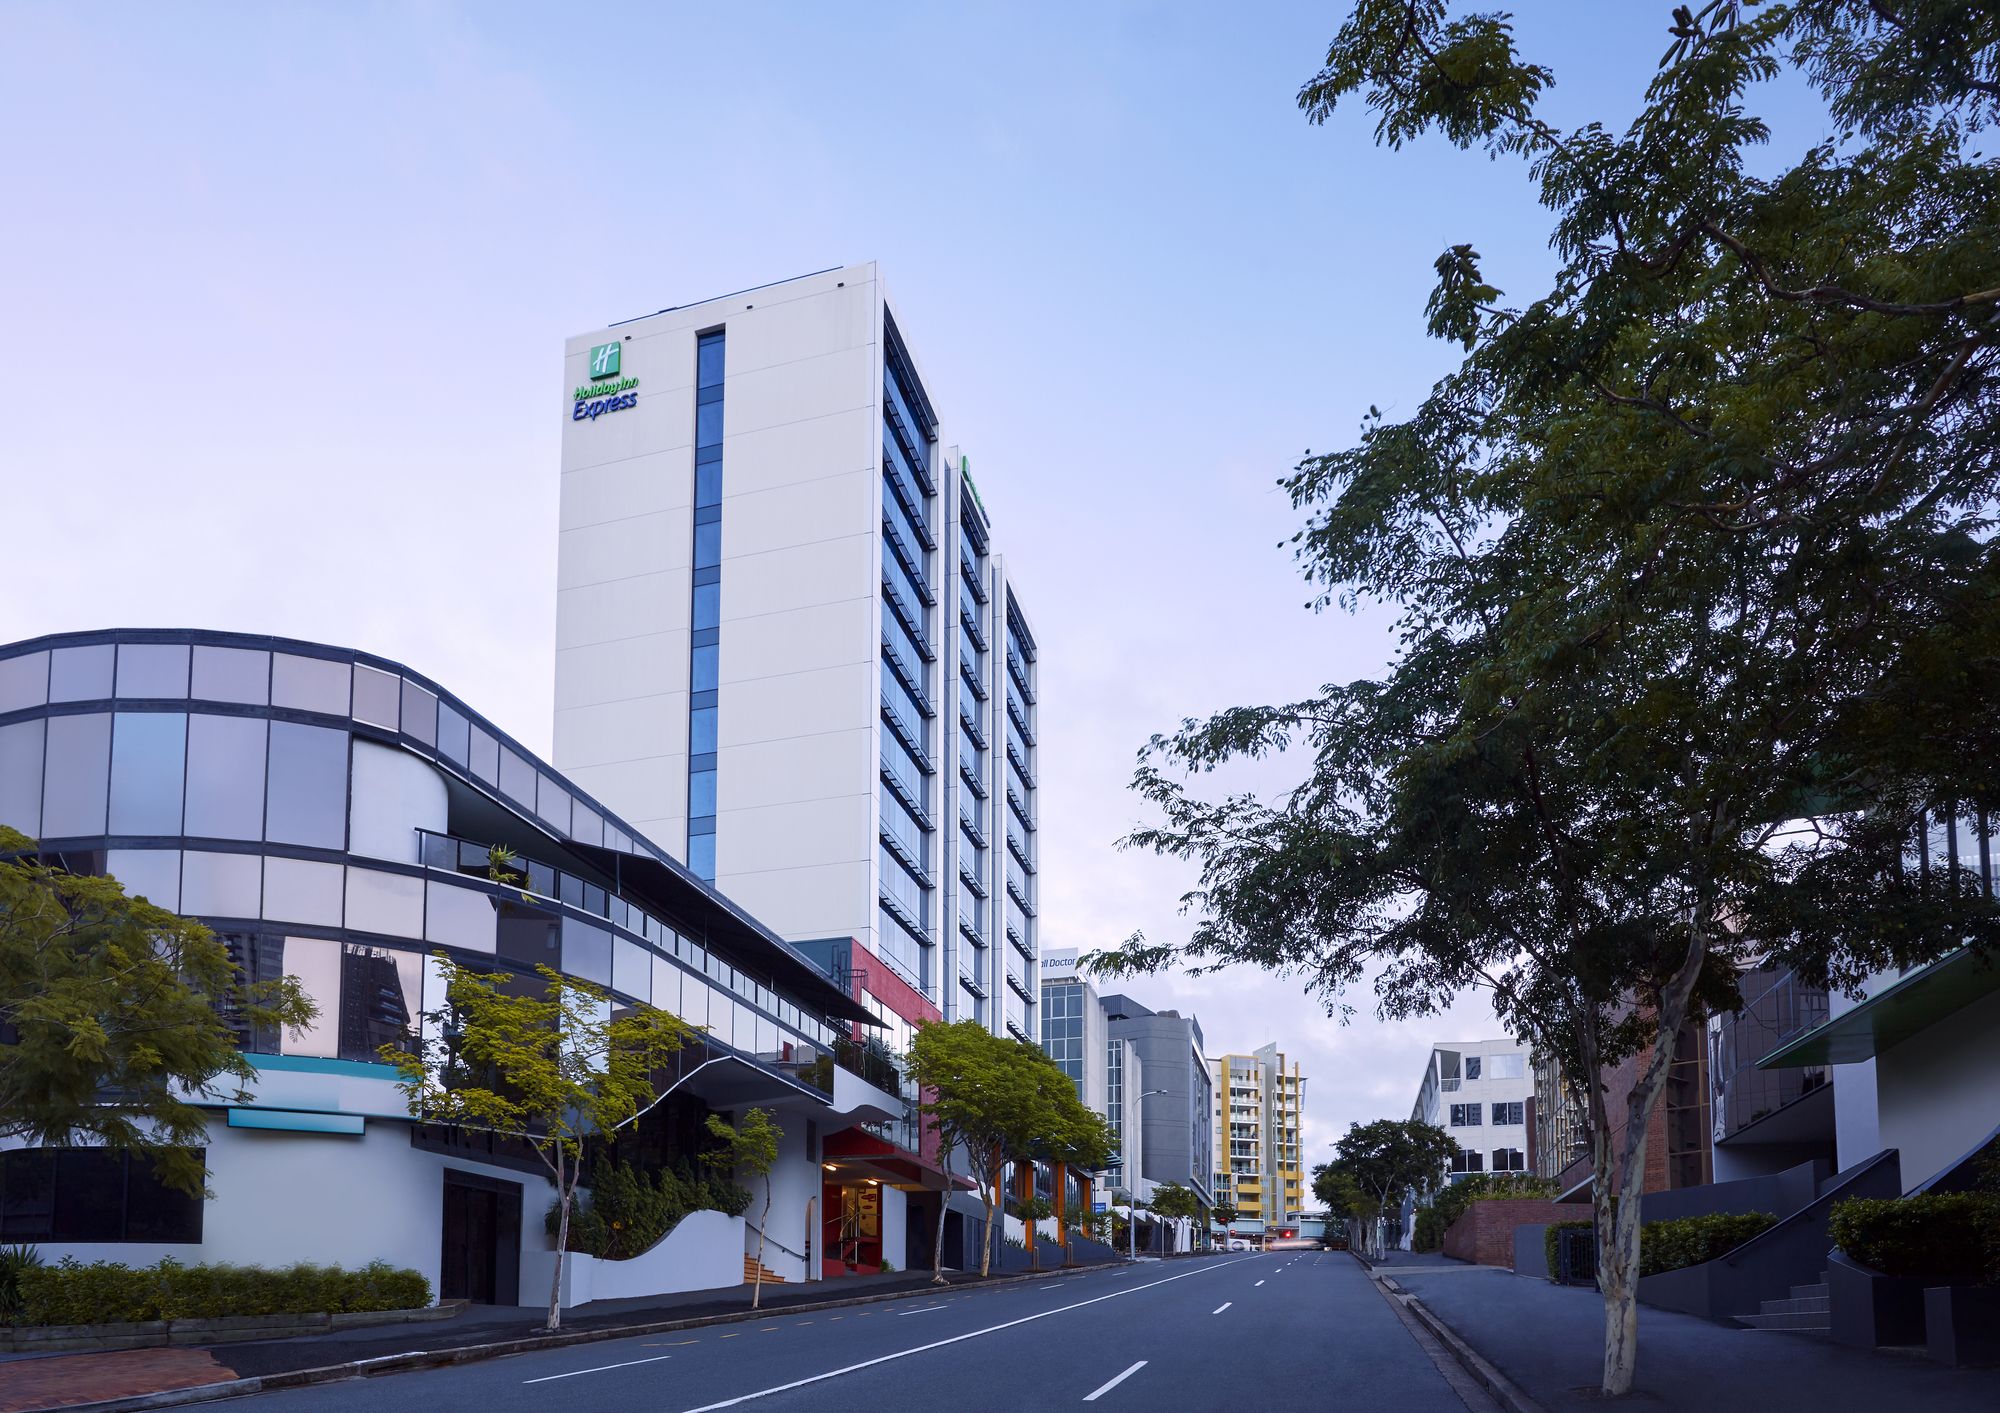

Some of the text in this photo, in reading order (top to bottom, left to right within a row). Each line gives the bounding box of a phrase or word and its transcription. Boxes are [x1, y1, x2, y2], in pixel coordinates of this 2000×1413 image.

[573, 376, 640, 400] Holiday Inn
[573, 391, 638, 421] Express
[1049, 958, 1076, 968] Doctor
